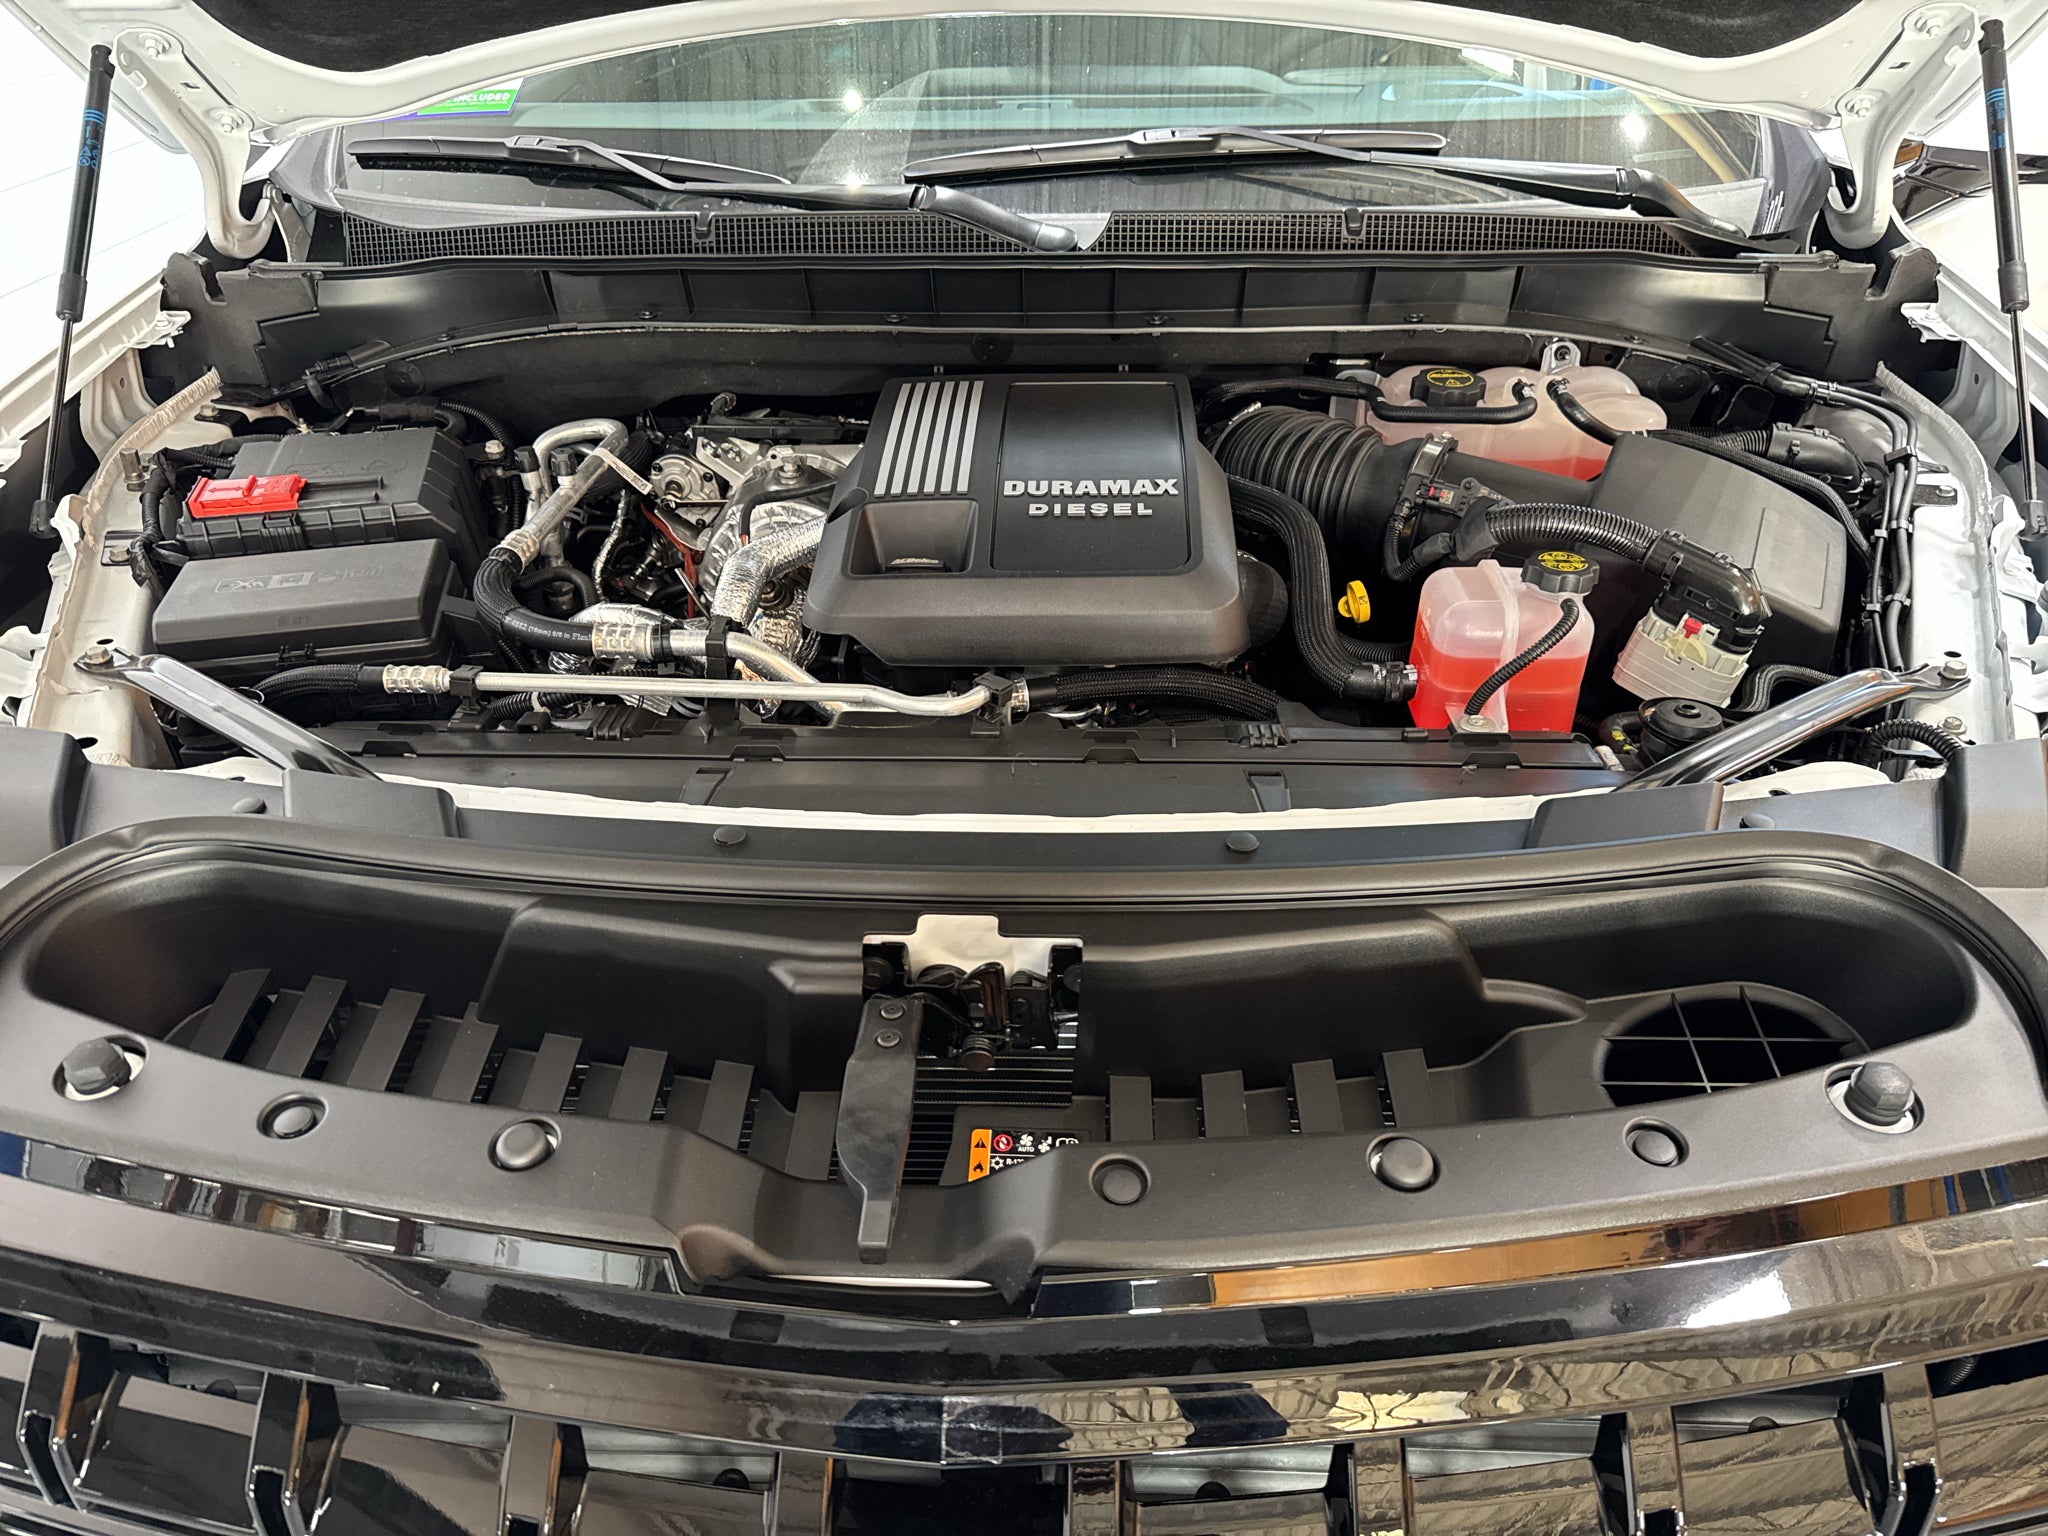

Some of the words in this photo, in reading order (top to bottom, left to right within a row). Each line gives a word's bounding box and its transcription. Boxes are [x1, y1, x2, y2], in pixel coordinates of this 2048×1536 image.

[1003, 479, 1179, 497] DURAMAX
[1029, 502, 1153, 517] DIESEL
[891, 557, 939, 565] ACDelco
[1018, 1145, 1035, 1153] AUTO
